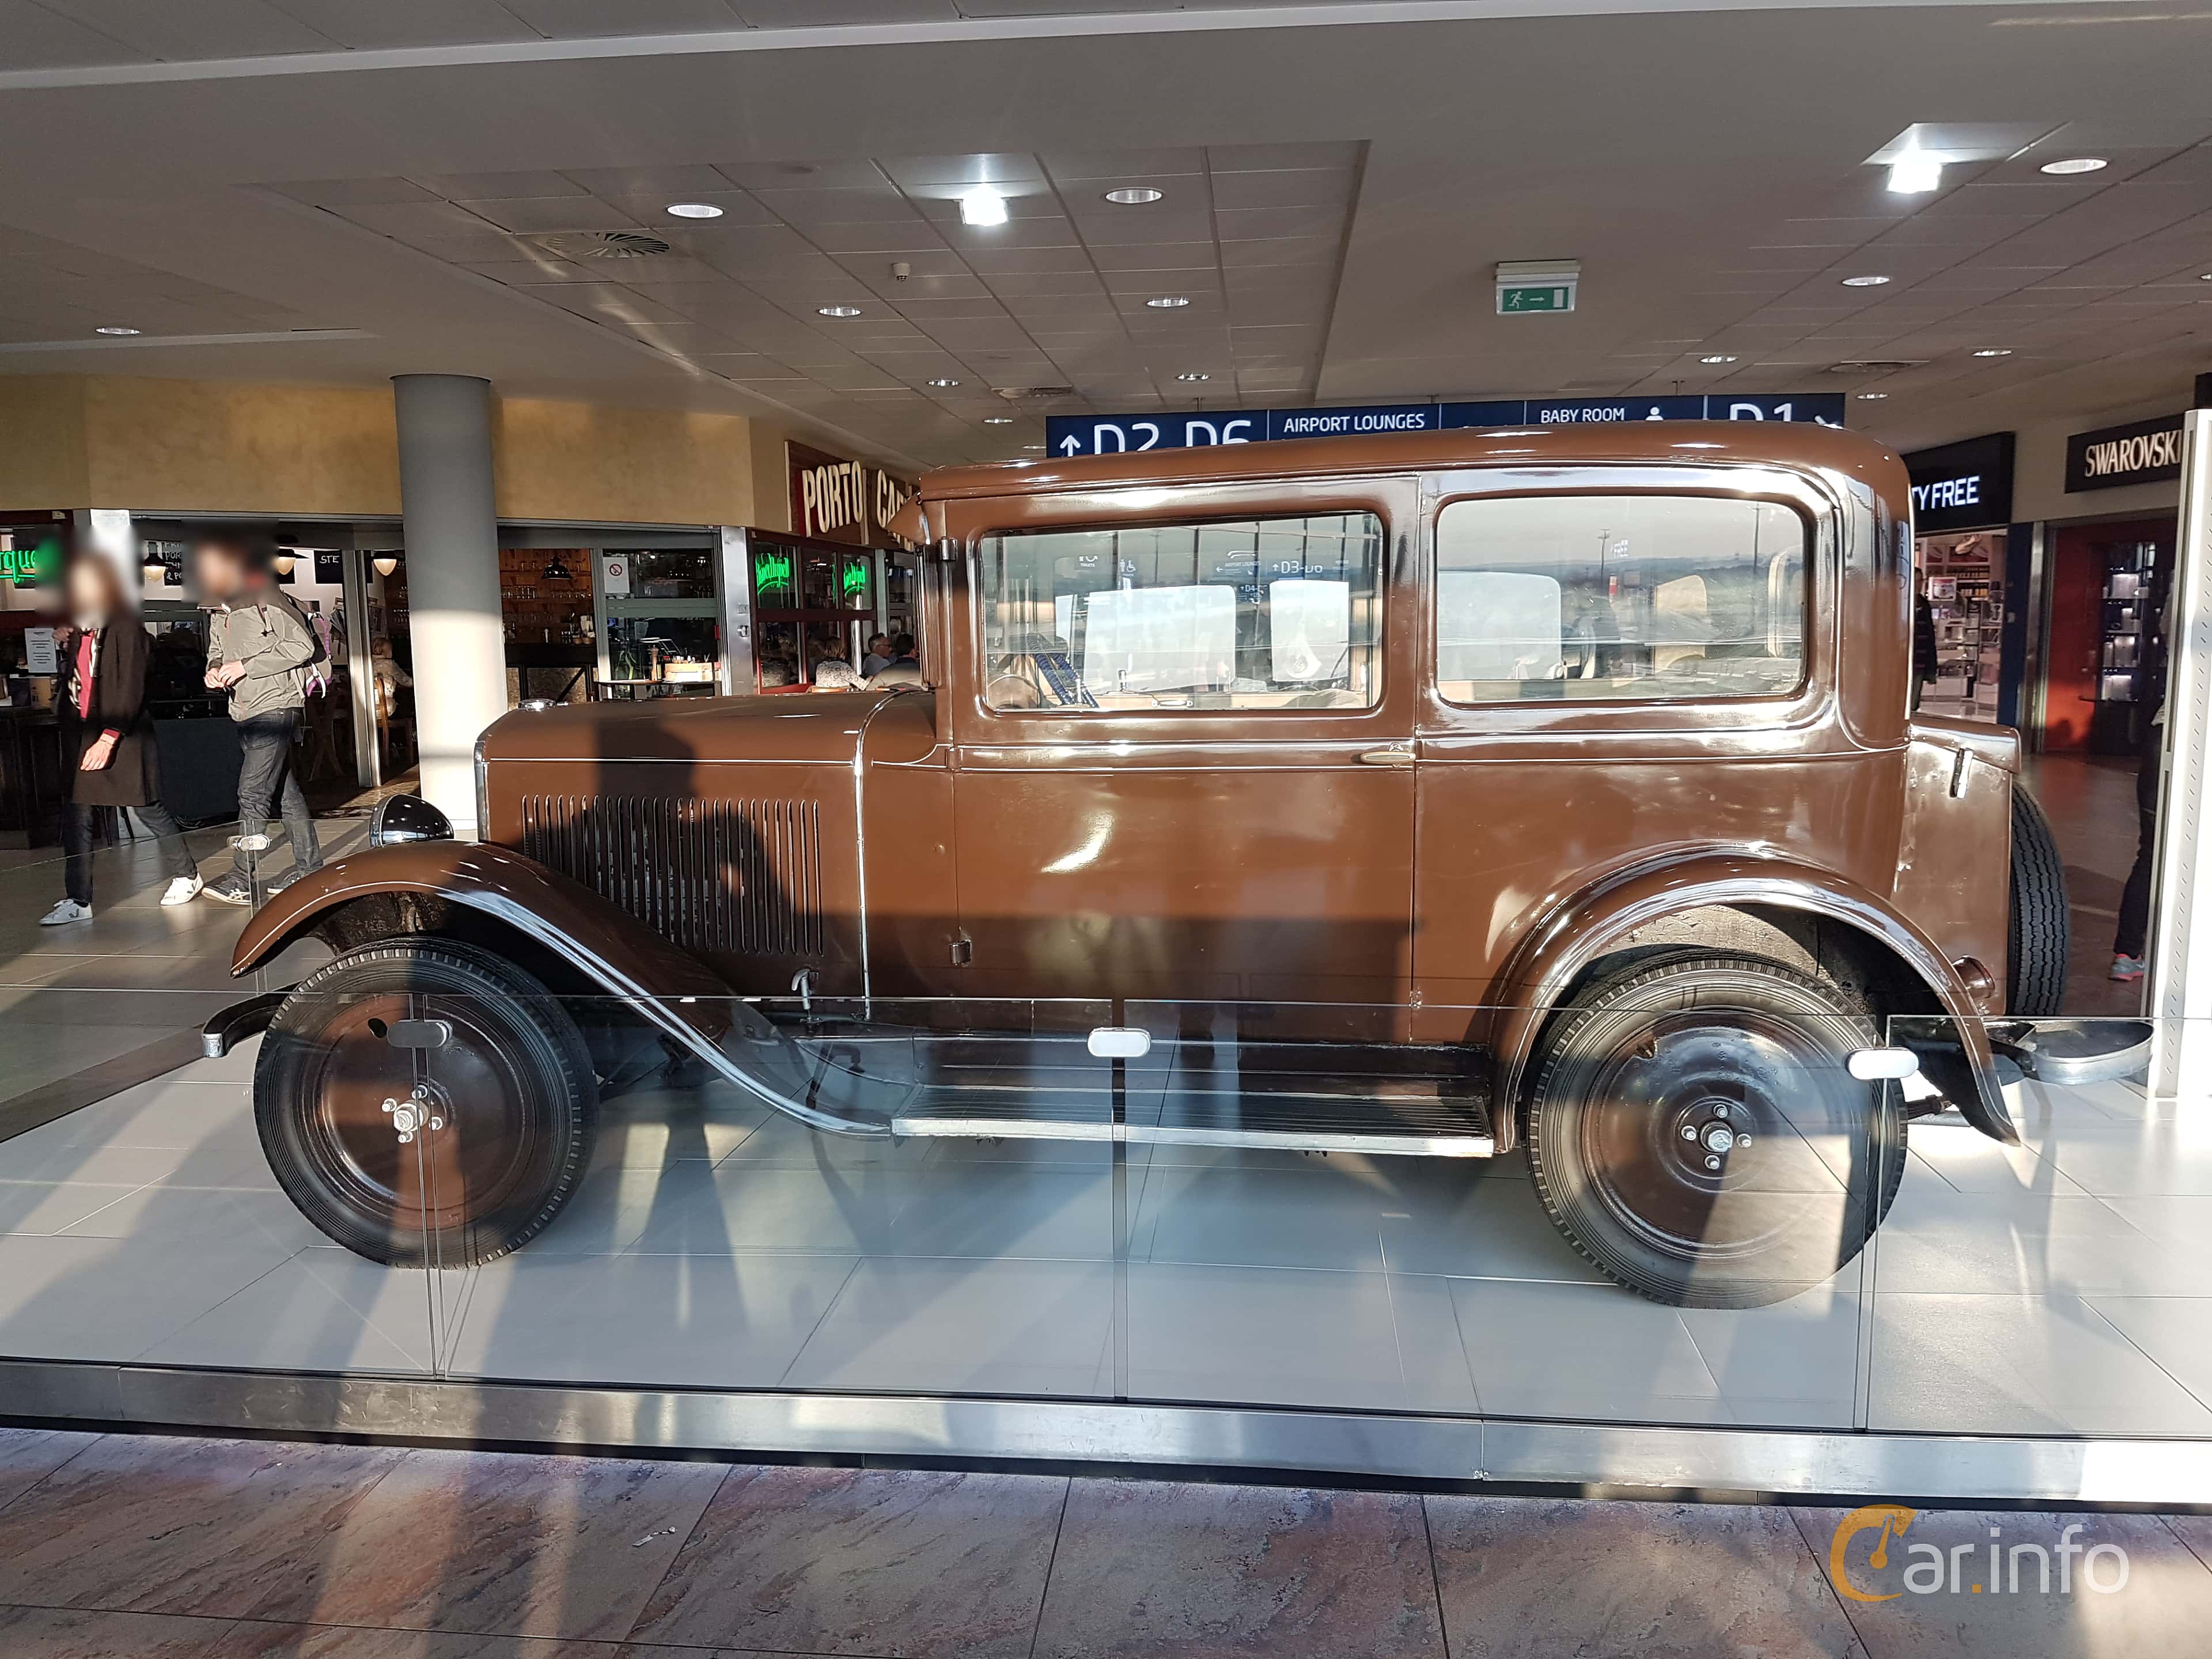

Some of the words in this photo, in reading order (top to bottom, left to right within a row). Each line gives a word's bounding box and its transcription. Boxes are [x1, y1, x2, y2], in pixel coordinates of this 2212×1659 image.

[1283, 416, 1350, 433] AIRPORT
[1354, 413, 1425, 430] LOUNGES
[1540, 409, 1579, 424] BABY
[1582, 407, 1625, 422] ROOM
[802, 460, 863, 539] PORTO
[1931, 475, 1980, 509] FREE
[319, 555, 340, 565] STE
